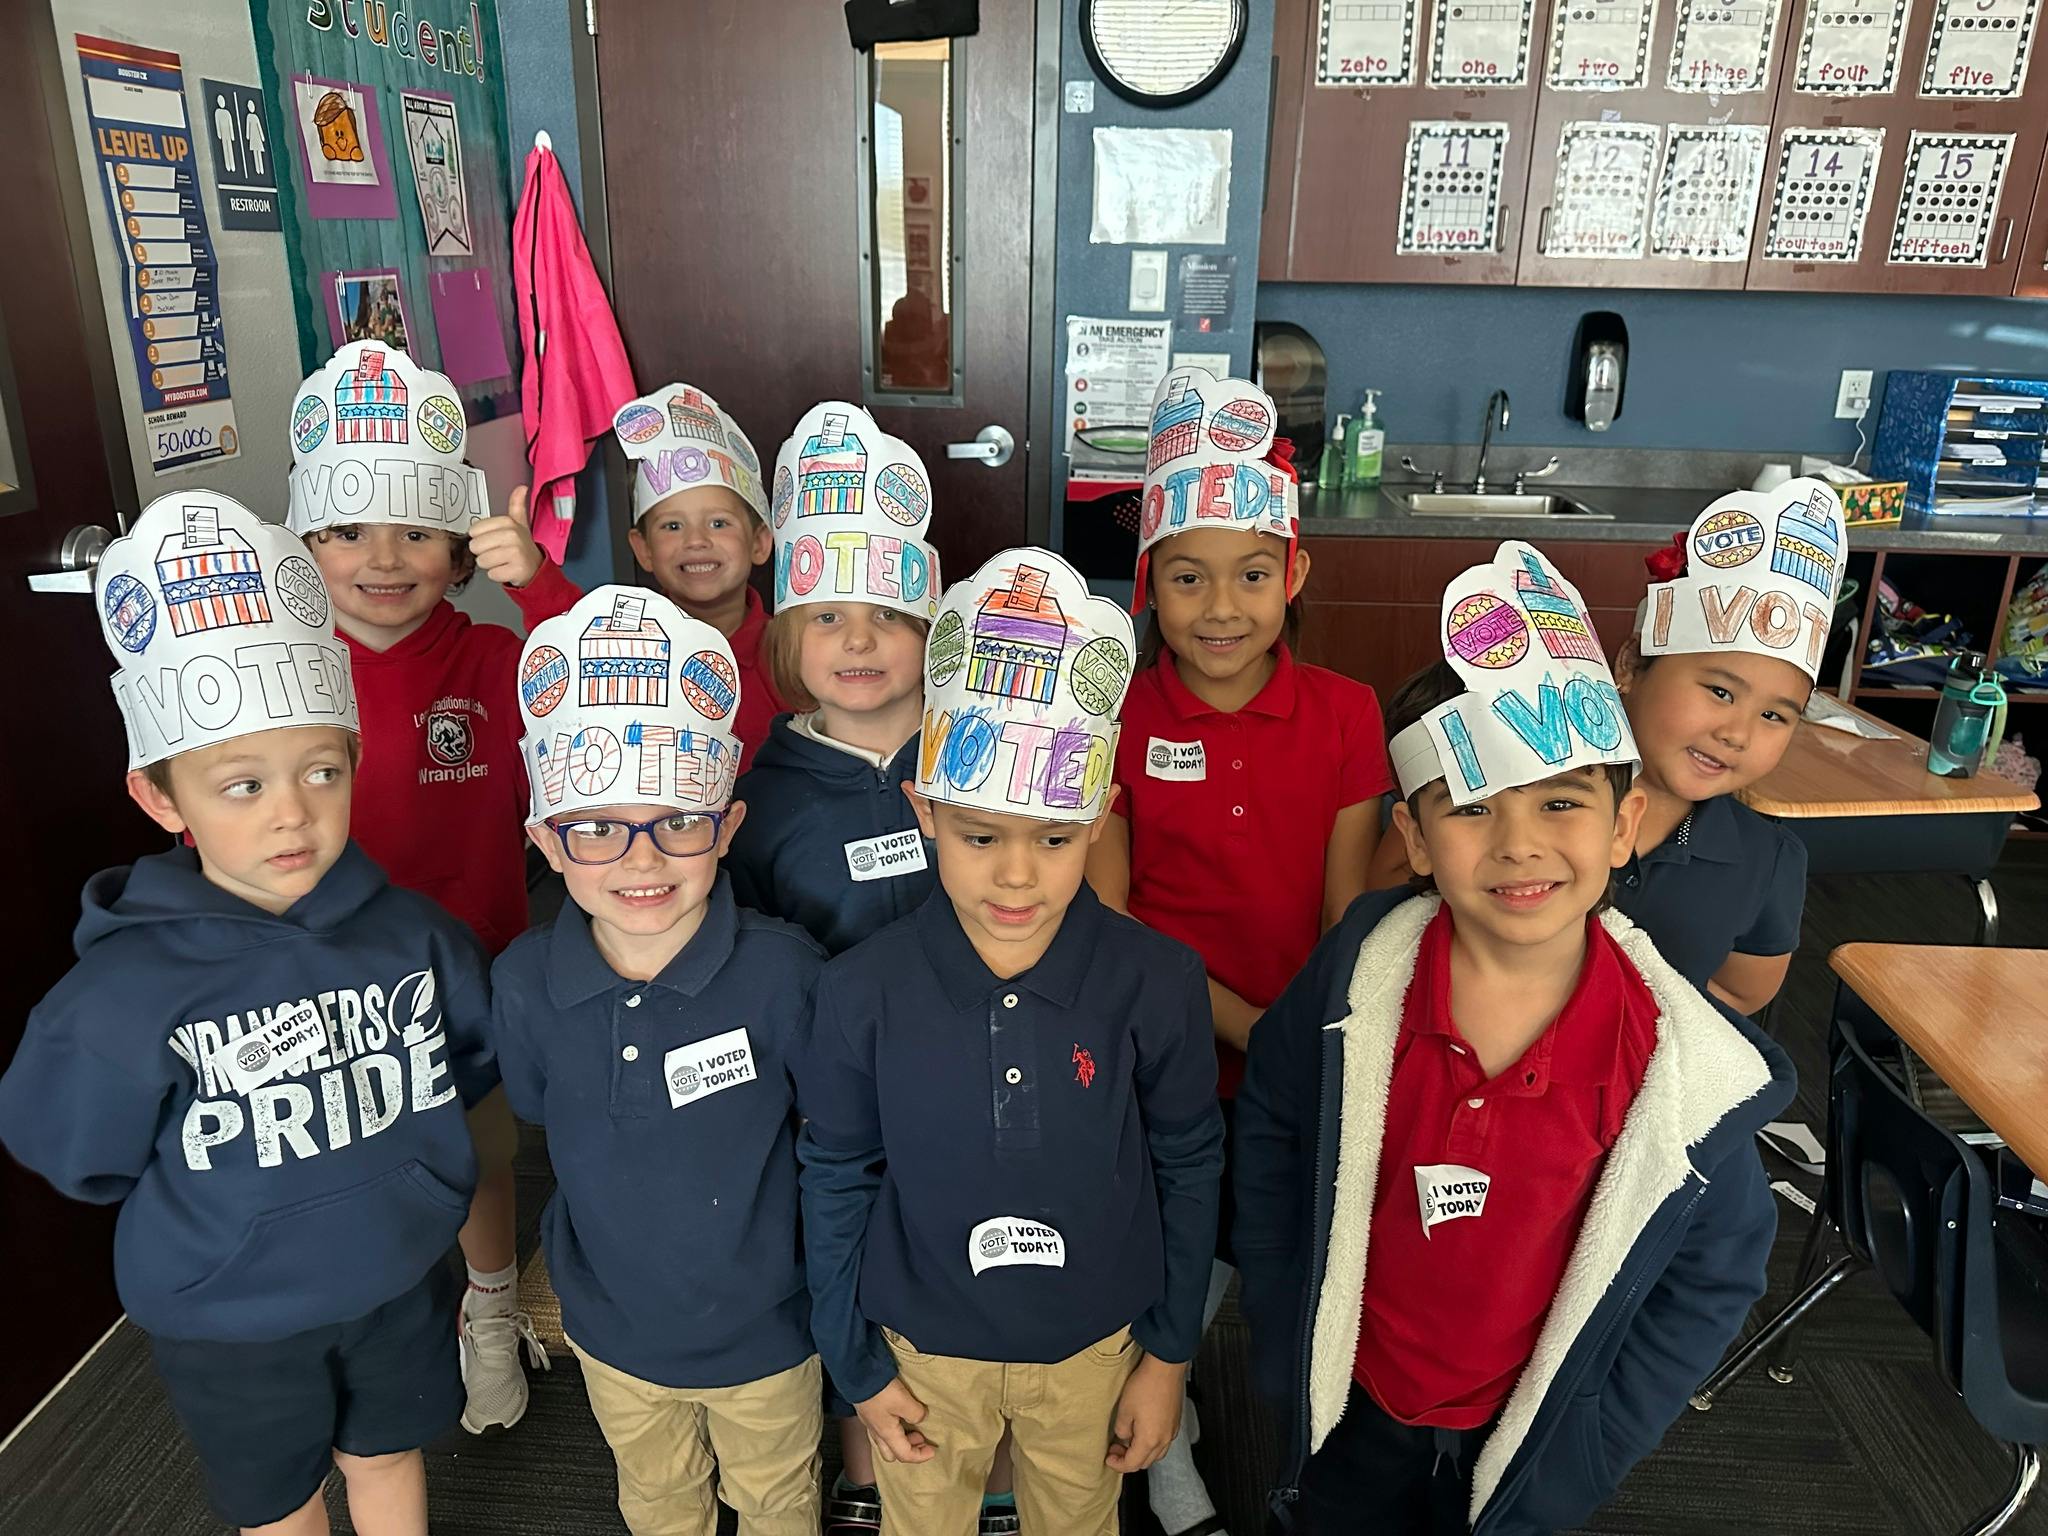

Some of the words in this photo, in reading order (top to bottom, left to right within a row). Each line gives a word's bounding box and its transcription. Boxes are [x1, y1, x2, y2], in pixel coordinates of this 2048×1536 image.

[1340, 56, 1388, 73] zero
[1462, 60, 1497, 75] one
[1578, 58, 1619, 76] two
[1689, 60, 1748, 80] three
[1819, 63, 1869, 82] four
[1949, 66, 1994, 85] five
[98, 128, 160, 160] LEVEL
[162, 135, 188, 162] UP
[1439, 137, 1470, 168] 11
[1585, 143, 1622, 171] 12
[1805, 148, 1843, 178] 14
[1934, 150, 1975, 180] 15
[230, 198, 271, 212] RESTROOM
[1416, 224, 1479, 242] eleven
[1776, 237, 1844, 251] fourteen
[1902, 238, 1970, 255] fifteen
[1089, 325, 1103, 336] AN
[1106, 326, 1165, 338] EMERGENCY
[164, 387, 208, 403] MYBOOSTER.COM
[148, 414, 165, 425] SCHOOL
[166, 411, 187, 422] REWARD
[295, 405, 328, 439] VOTE
[423, 404, 461, 446] VOTE
[1216, 410, 1265, 439] VOTE
[158, 426, 212, 458] 50,000
[882, 471, 926, 519] VOTE
[1697, 525, 1762, 554] VOTE
[776, 531, 937, 617] VOTED!
[281, 568, 327, 614] VOTE
[1653, 587, 1674, 647] I
[1455, 606, 1524, 654] VOTE
[930, 631, 963, 662] VOTE
[523, 659, 567, 701] VOTE
[1081, 649, 1122, 701] VOTE
[1151, 752, 1171, 762] VOTE
[1439, 709, 1487, 792] I
[418, 761, 488, 784] Wranglers
[874, 843, 880, 853] I
[881, 833, 917, 851] VOTED
[853, 853, 875, 865] VOTE
[878, 847, 920, 867] TODAY!
[263, 1032, 271, 1044] I
[272, 1008, 313, 1038] VOTED
[271, 1023, 320, 1058] TODAY!
[239, 1045, 269, 1067] VOTE
[698, 1061, 704, 1073] I
[706, 1049, 747, 1069] VOTED
[673, 1073, 699, 1087] VOTE
[702, 1064, 750, 1088] TODAY!
[182, 1031, 457, 1171] PRIDE
[1432, 1185, 1439, 1198] I
[1441, 1182, 1488, 1196] VOTED
[1007, 1225, 1013, 1237] I
[1015, 1226, 1056, 1237] VOTED
[981, 1236, 1006, 1250] VOTE
[1010, 1241, 1059, 1254] TODAY!
